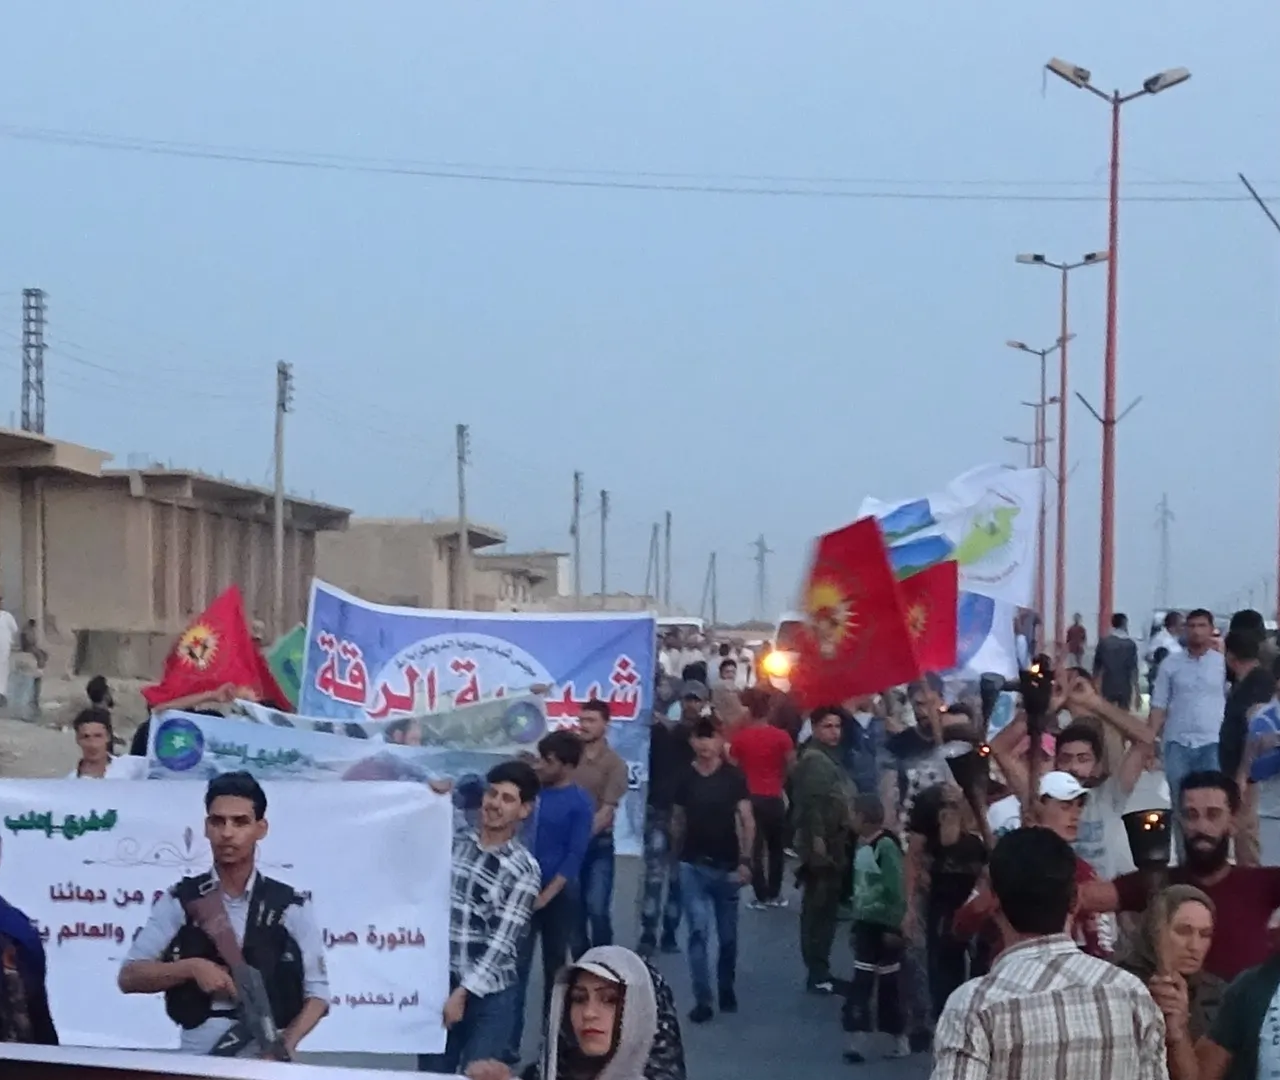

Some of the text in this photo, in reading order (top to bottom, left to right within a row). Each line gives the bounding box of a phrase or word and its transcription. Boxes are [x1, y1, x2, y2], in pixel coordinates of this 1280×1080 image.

[317, 632, 641, 733] شية الرقة
[49, 880, 107, 904] دمائنا
[113, 886, 145, 908] من
[57, 921, 126, 947] والعالم
[322, 927, 359, 949] صرا
[365, 923, 426, 952] فاتورة
